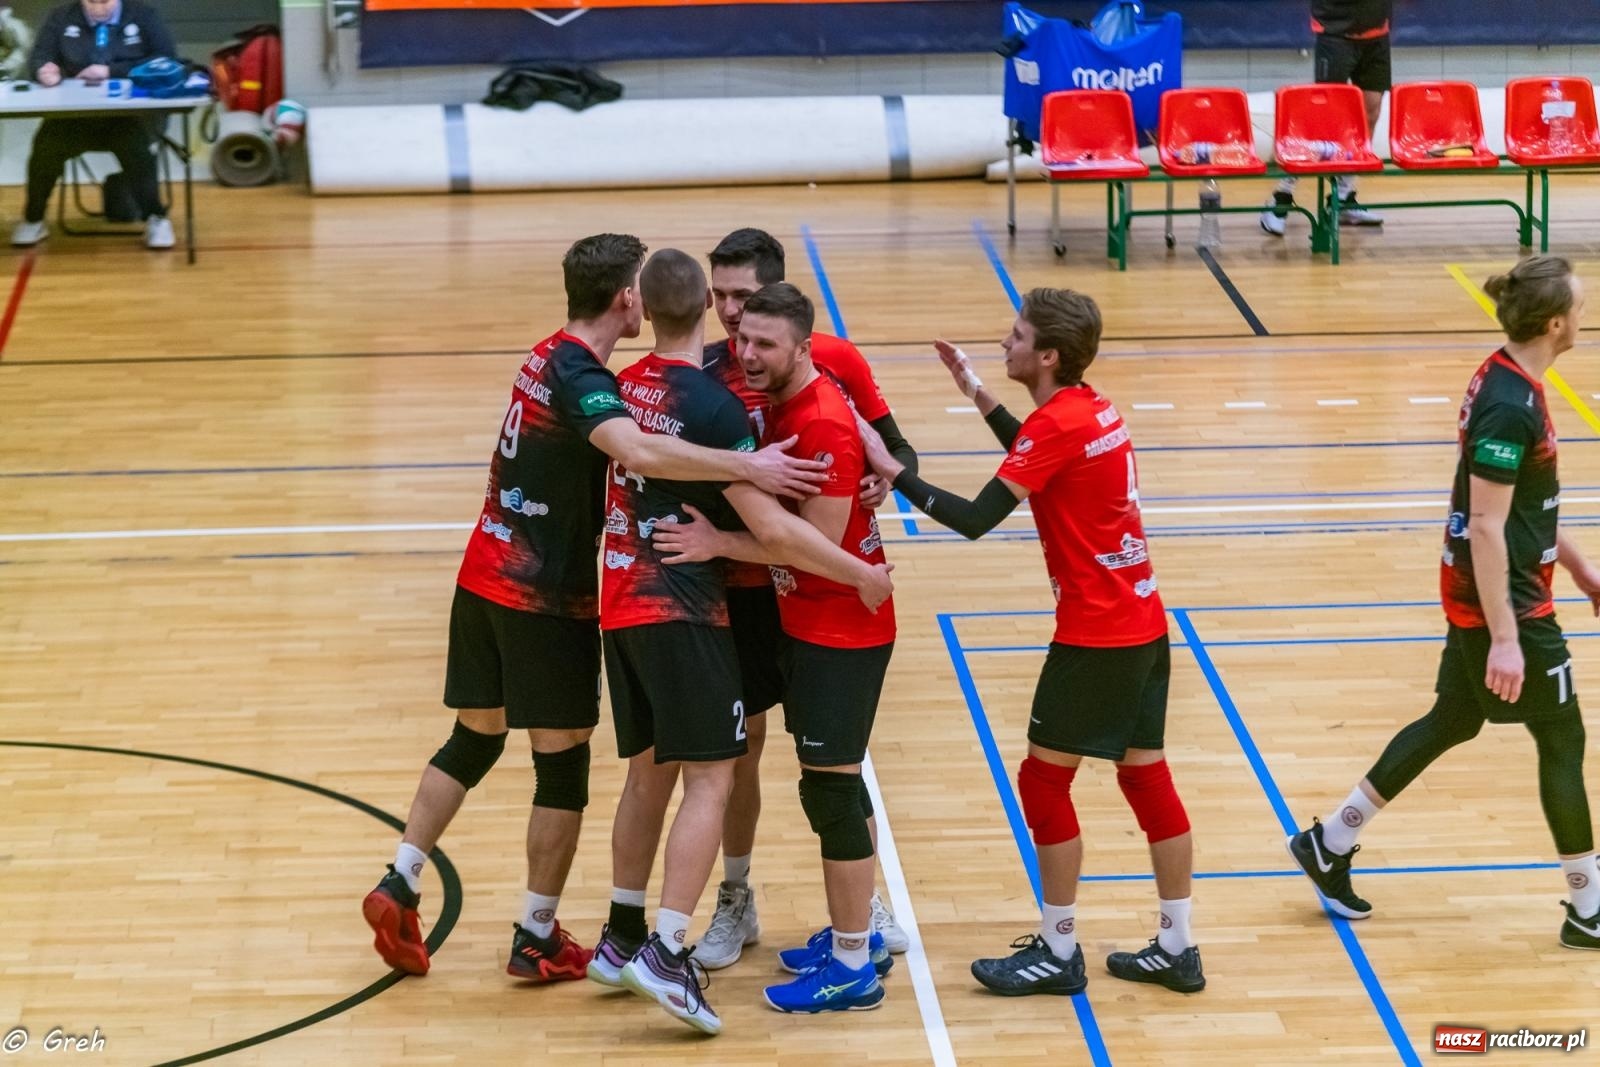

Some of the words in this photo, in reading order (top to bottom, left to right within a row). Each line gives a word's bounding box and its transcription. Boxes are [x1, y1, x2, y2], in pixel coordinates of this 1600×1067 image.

[1072, 62, 1163, 91] molten
[632, 384, 666, 406] VOLLEY
[500, 400, 523, 459] 9
[643, 408, 685, 438] ŚLĄSKIE
